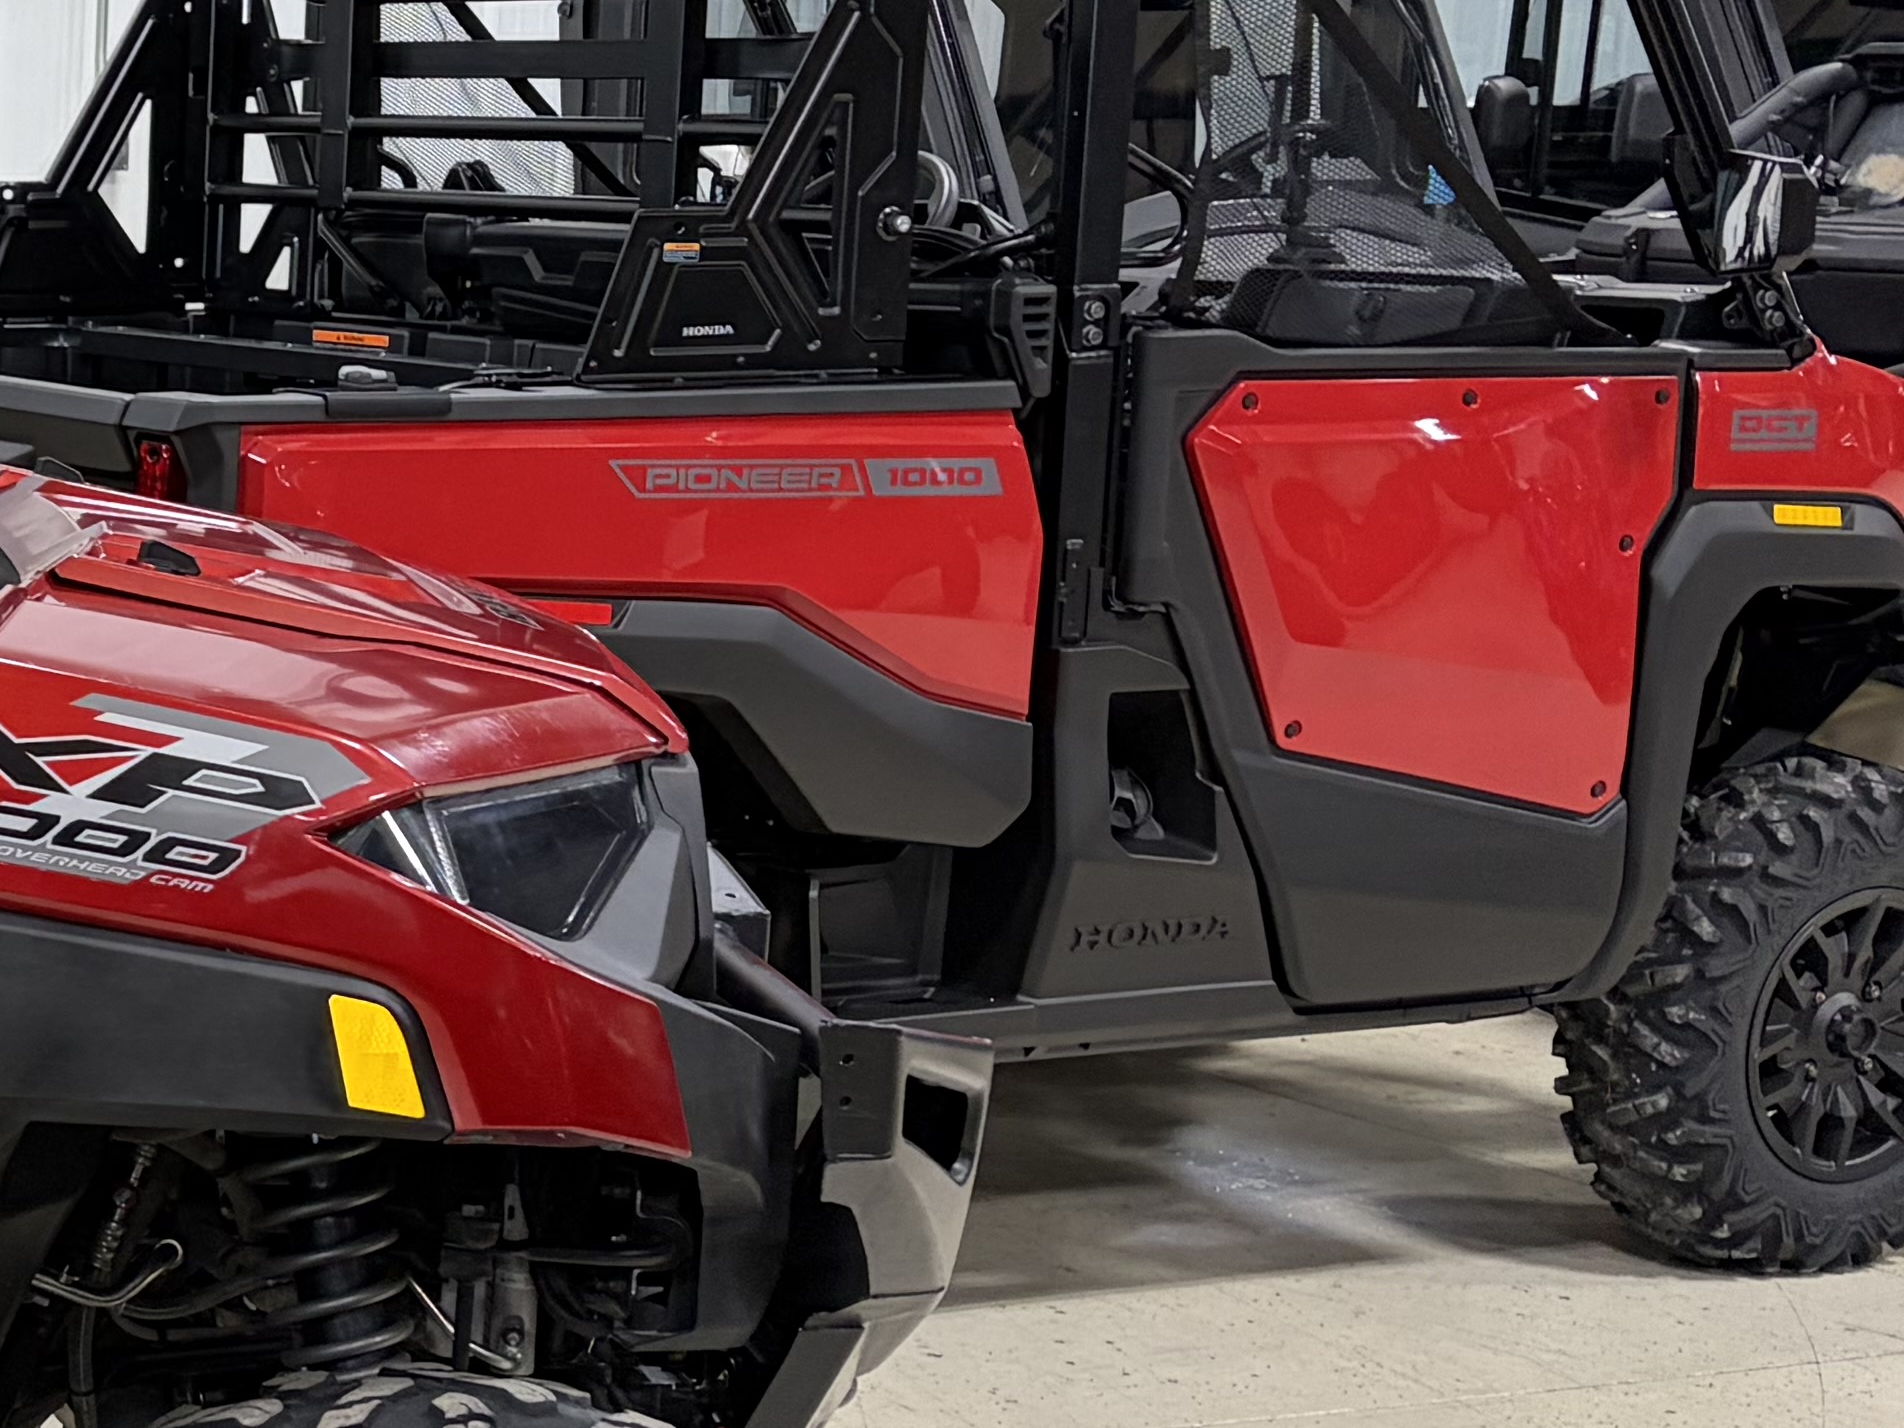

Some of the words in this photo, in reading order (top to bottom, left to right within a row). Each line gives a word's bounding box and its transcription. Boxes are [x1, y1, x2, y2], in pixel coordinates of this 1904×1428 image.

[682, 324, 734, 337] HONDA
[1739, 416, 1815, 433] DCT
[645, 465, 842, 491] PIONEER
[888, 465, 985, 488] 1000
[149, 874, 214, 894] CAM
[1069, 915, 1229, 952] HONDA
